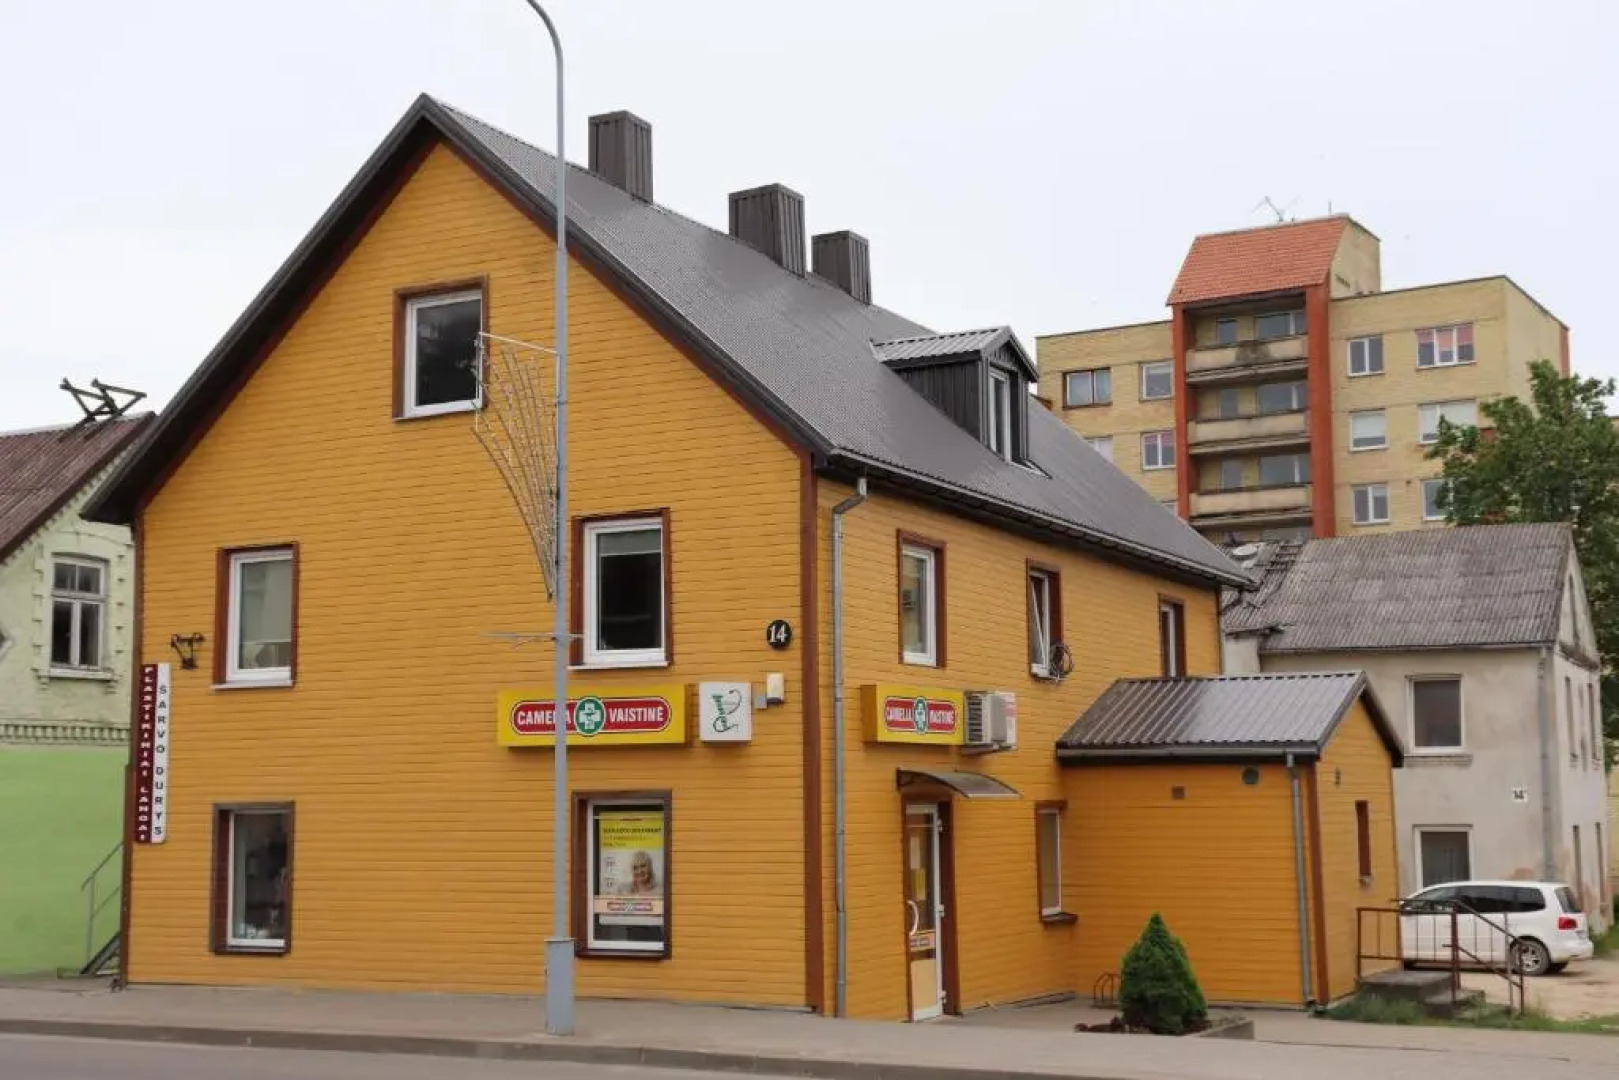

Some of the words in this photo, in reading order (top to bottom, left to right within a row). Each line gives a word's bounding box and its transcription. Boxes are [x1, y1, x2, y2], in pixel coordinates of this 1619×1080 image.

[769, 624, 788, 643] 14
[517, 709, 573, 725] CAMEA
[138, 786, 149, 841] LANGAI
[154, 766, 164, 836] DURYS
